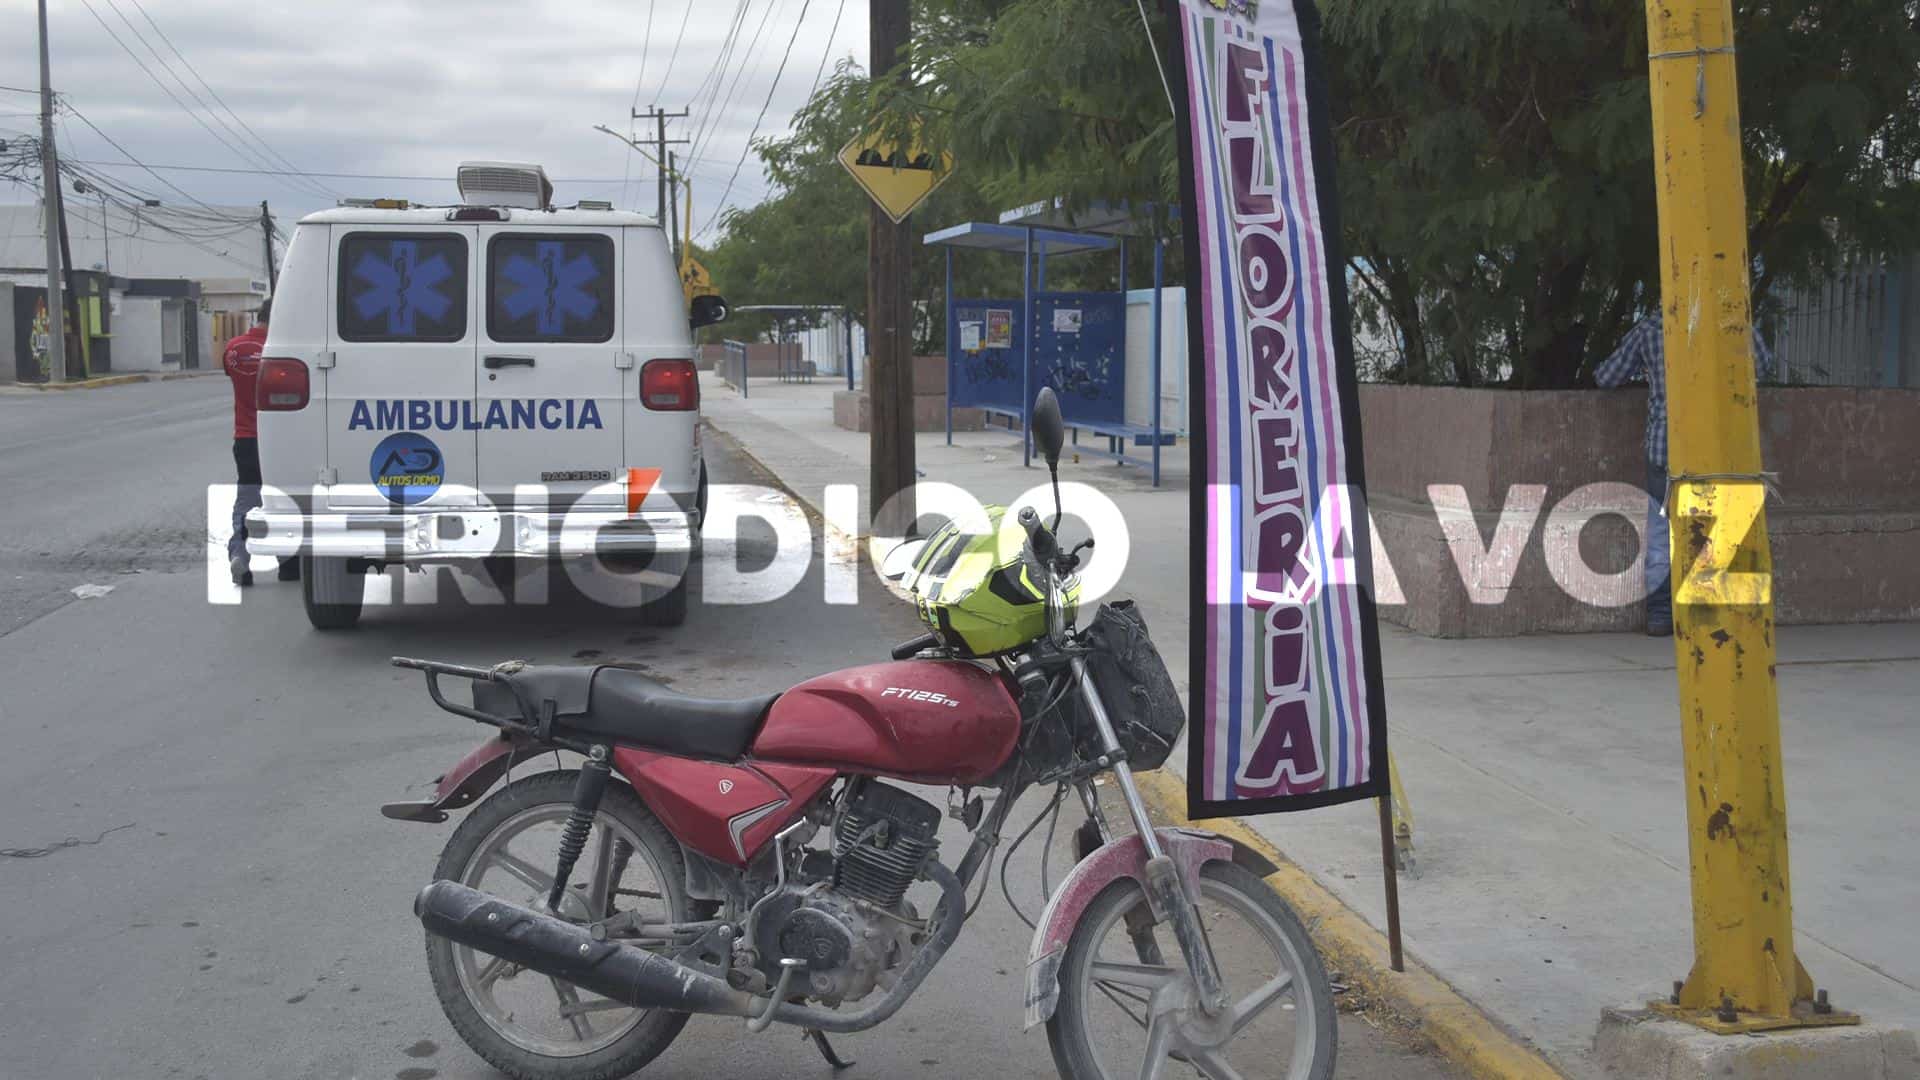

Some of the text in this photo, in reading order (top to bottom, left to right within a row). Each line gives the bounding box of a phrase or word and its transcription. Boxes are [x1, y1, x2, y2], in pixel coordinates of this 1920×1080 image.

[348, 399, 603, 431] AMBULANCIA
[376, 474, 441, 487] AUTOS DEMO
[541, 471, 611, 482] RAM 3500
